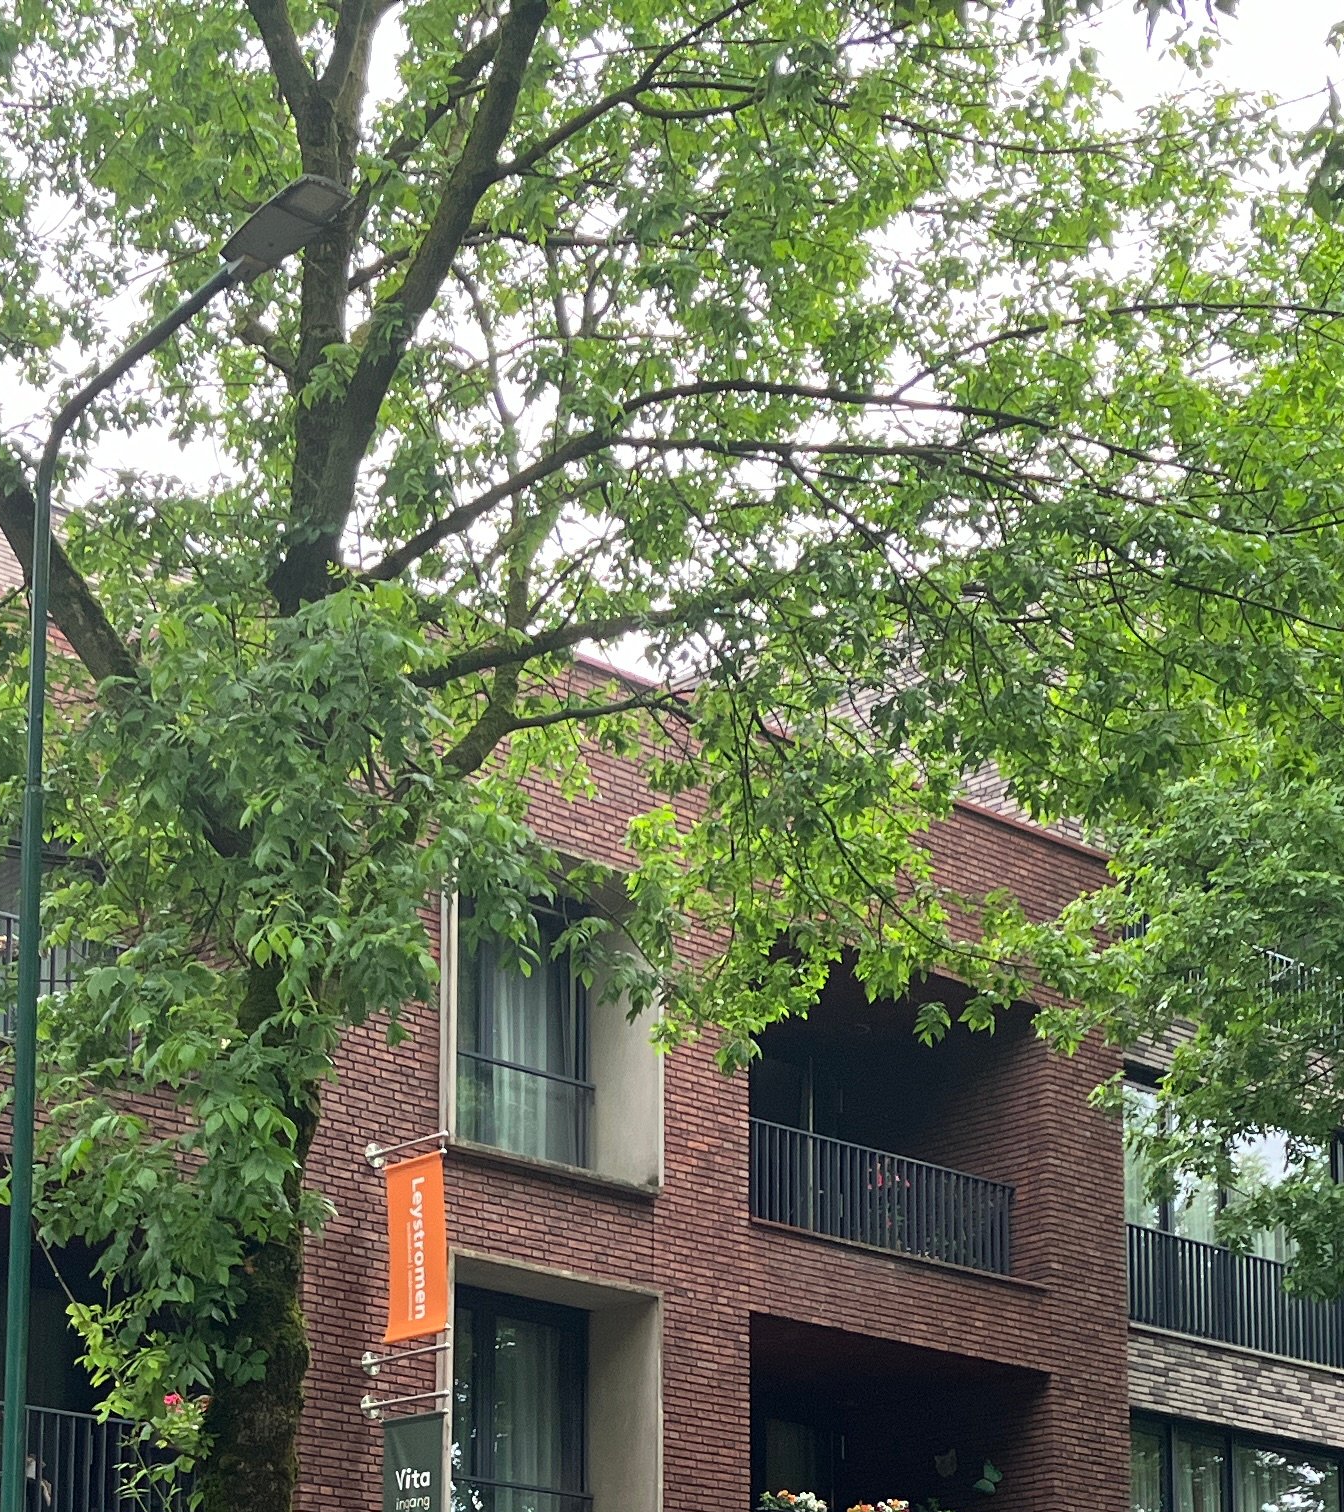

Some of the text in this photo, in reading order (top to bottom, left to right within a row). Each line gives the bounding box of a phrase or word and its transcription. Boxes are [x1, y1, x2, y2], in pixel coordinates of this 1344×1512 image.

[410, 1176, 426, 1320] Leystromen
[395, 1467, 431, 1491] Vita
[395, 1496, 431, 1512] ingang
